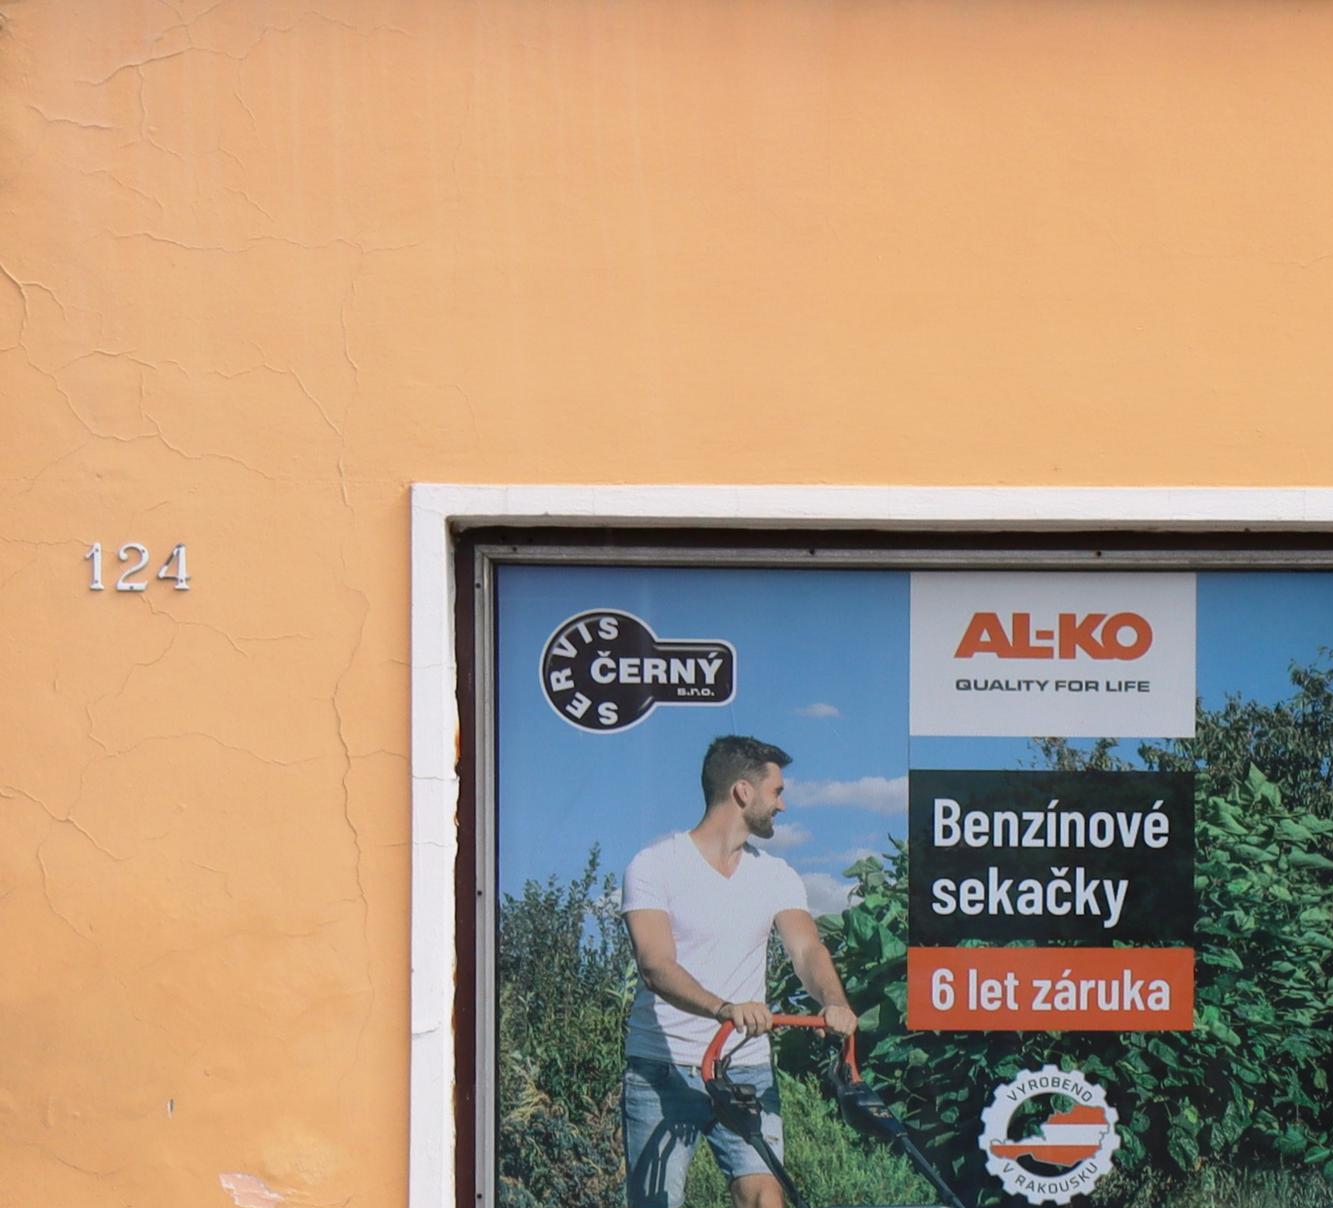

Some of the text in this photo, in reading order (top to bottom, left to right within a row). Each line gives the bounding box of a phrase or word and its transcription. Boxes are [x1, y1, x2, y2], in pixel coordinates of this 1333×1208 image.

[84, 542, 192, 591] 124
[954, 612, 1153, 661] AL-KO
[550, 616, 619, 726] SERVIS
[590, 650, 723, 686] ČERNÝ
[955, 679, 1151, 692] QUALITY FOR LIFE
[677, 687, 716, 697] s.r.o.
[933, 797, 1171, 849] Benzínové
[931, 866, 1130, 929] sekačky
[931, 968, 1171, 1012] 6 let záruka
[1007, 1076, 1093, 1103] VYROBENO
[1002, 1161, 1099, 1195] V RAKOUSKU
